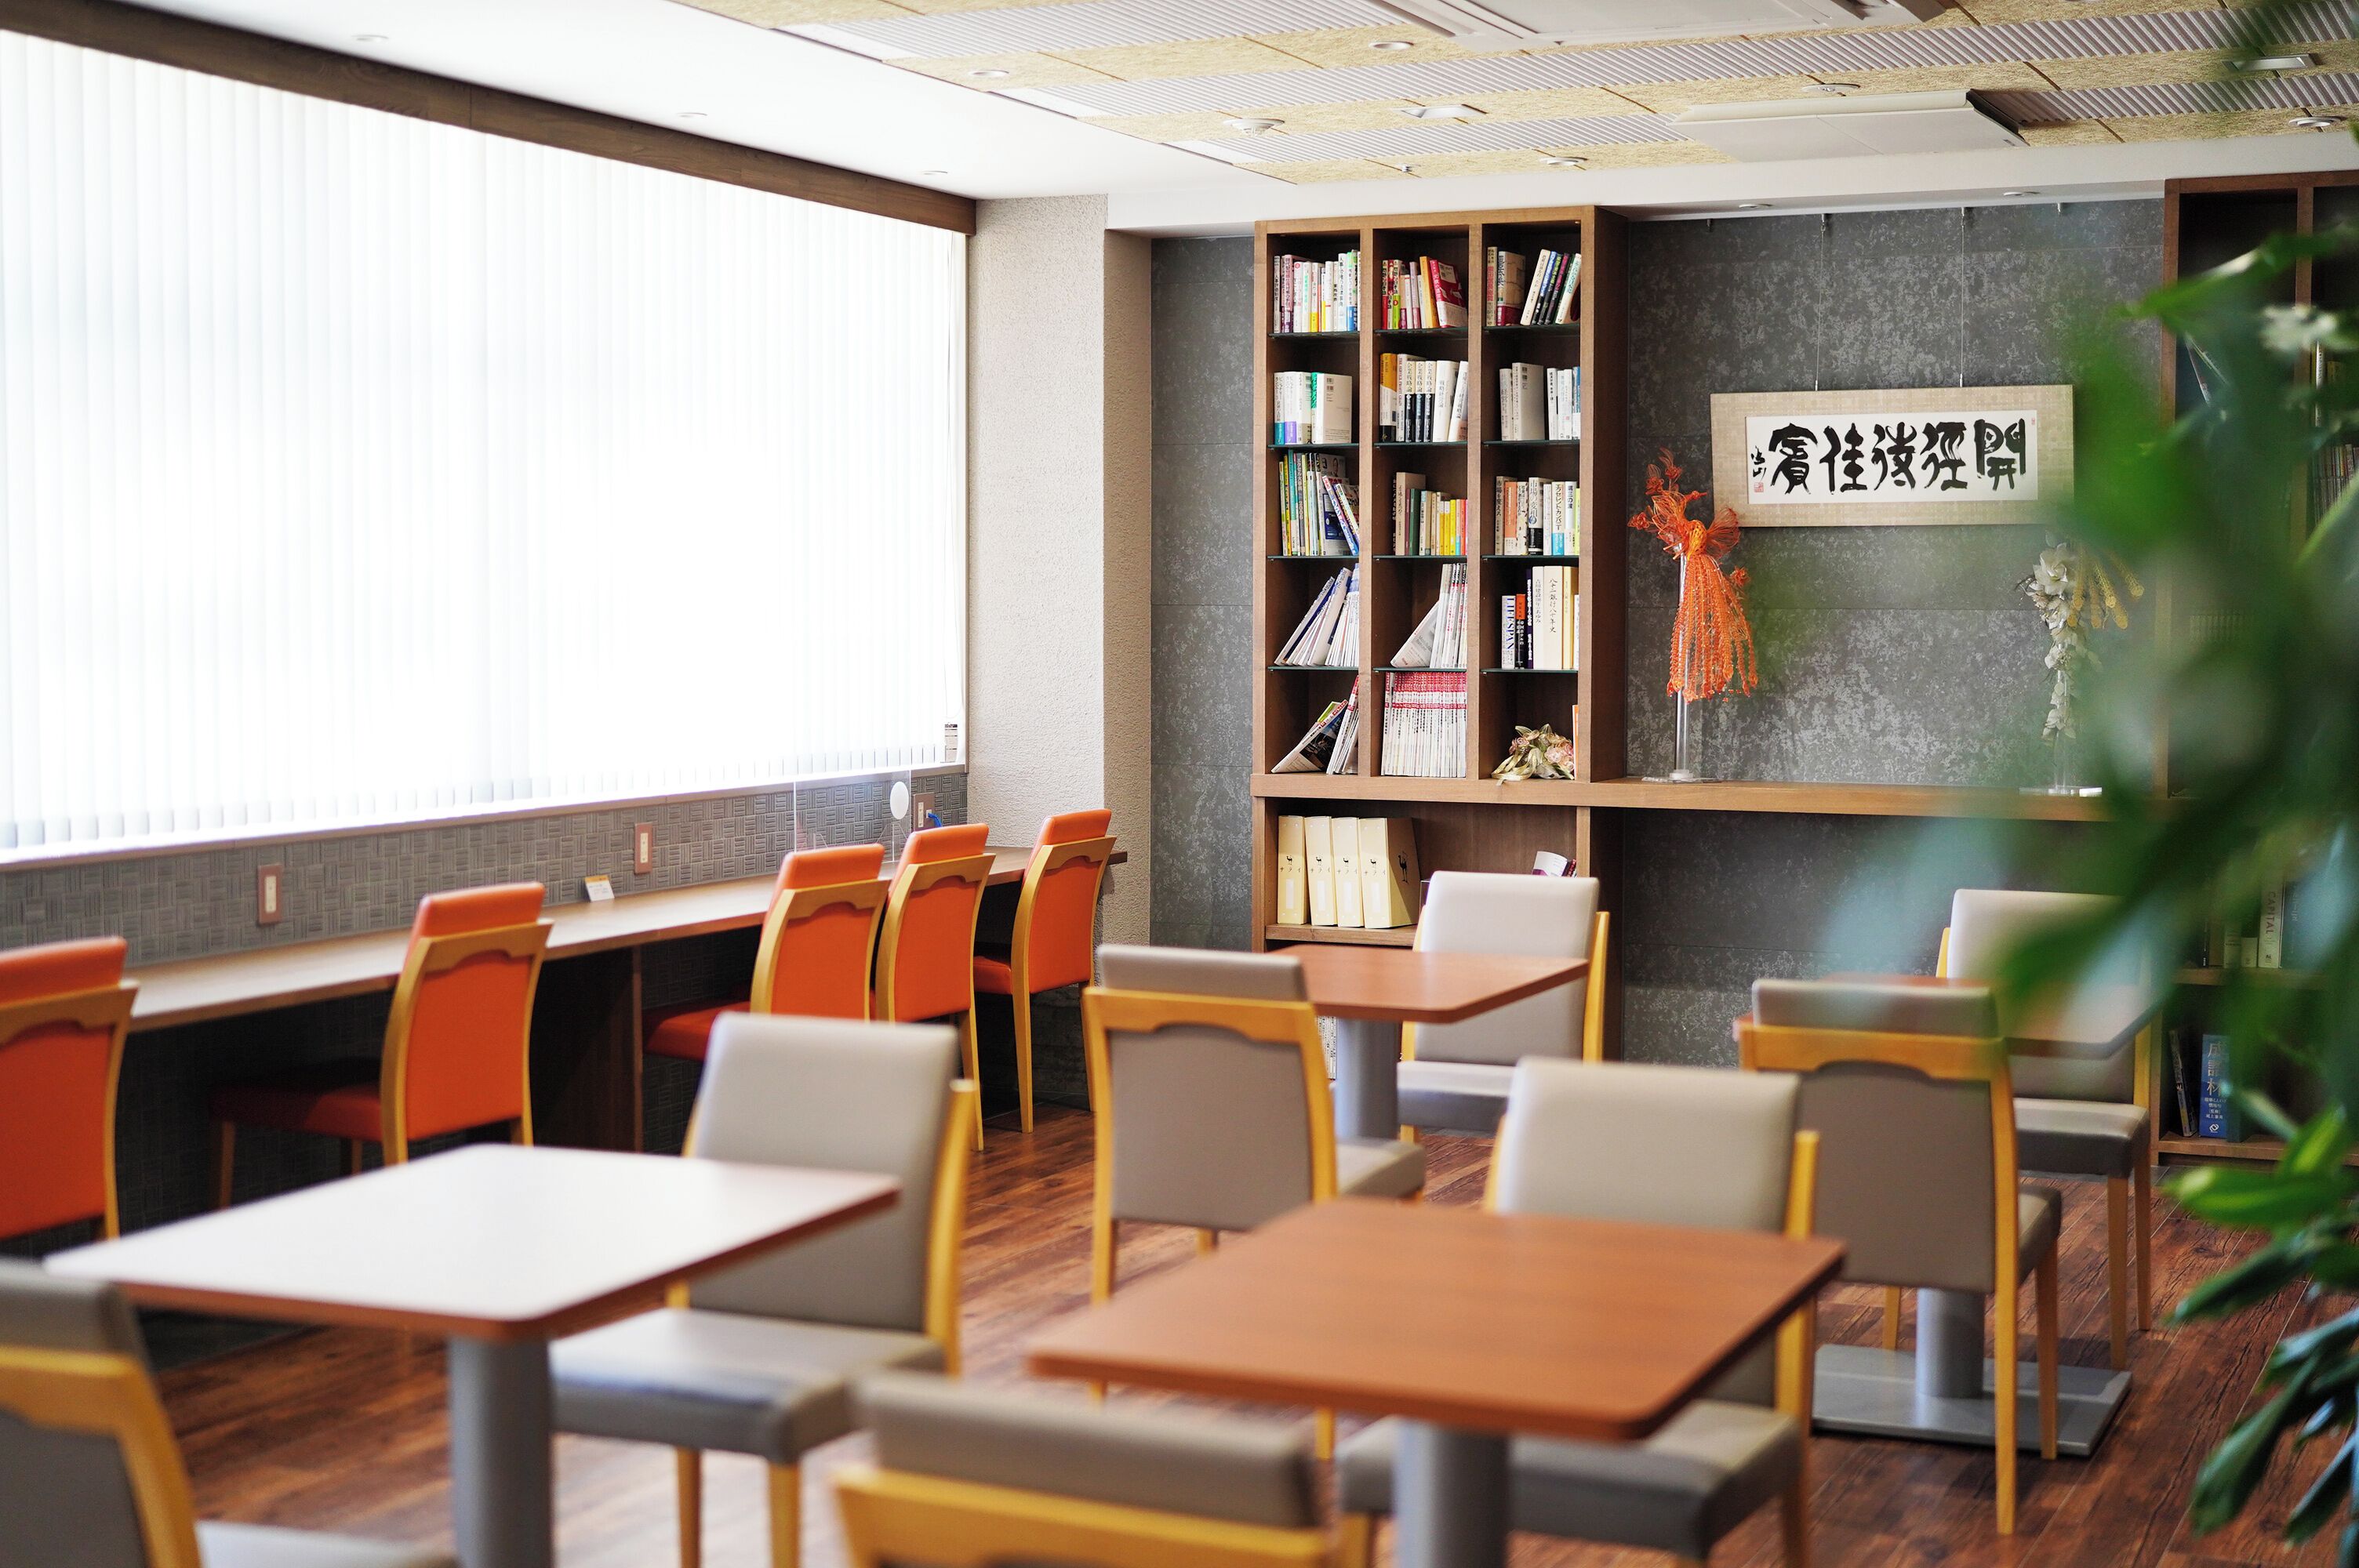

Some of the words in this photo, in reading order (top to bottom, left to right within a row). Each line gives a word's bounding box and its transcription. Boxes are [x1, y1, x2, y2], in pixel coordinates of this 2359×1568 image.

[1550, 578, 1558, 633] 八十二銀行八十年史
[2266, 891, 2277, 935] CAPITAL
